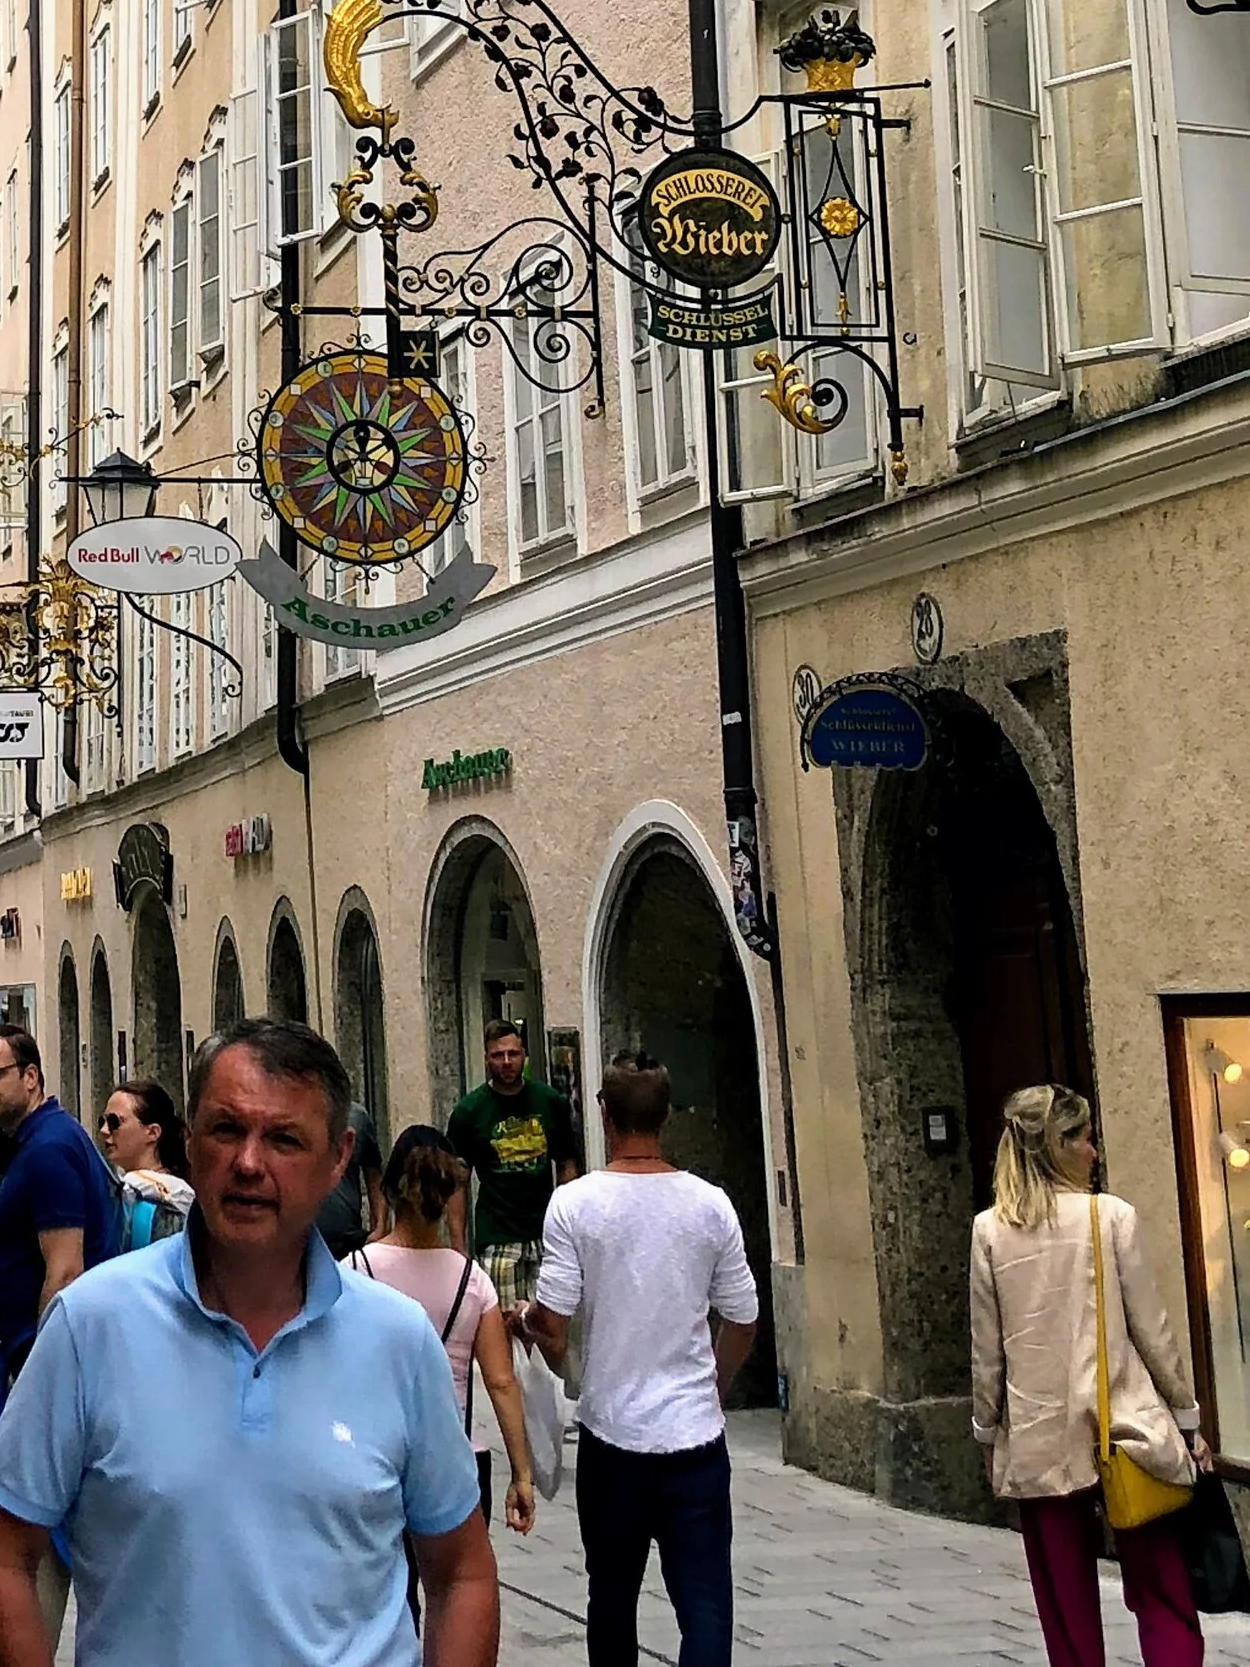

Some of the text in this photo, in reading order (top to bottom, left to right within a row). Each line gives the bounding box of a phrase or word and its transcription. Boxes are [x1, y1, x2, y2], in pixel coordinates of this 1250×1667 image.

[656, 173, 763, 211] SCHLOSSEREI
[651, 213, 769, 256] Wieber
[665, 323, 758, 343] DIENST
[280, 595, 456, 639] Aschauer
